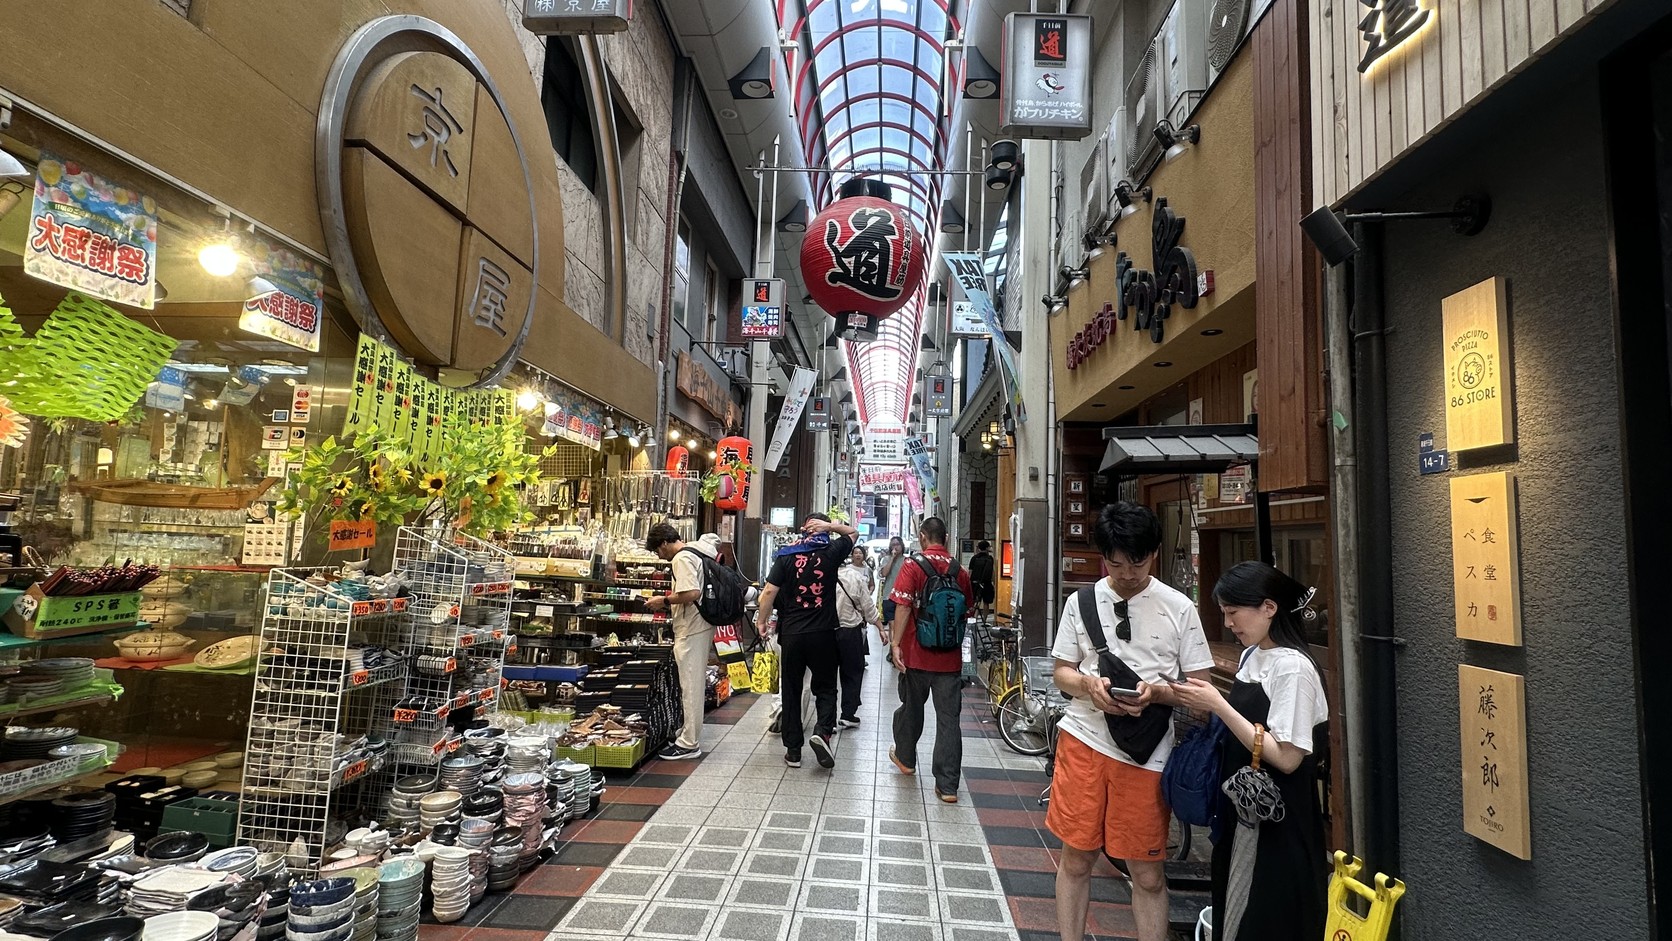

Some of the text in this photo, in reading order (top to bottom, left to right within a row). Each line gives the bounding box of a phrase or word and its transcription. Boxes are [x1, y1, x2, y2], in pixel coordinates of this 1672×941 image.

[1039, 31, 1065, 59] 道
[33, 213, 149, 284] 大感謝祭
[825, 208, 904, 301] 道
[1451, 330, 1489, 351] PROSCIUTTO
[1461, 341, 1478, 352] PIZZA
[349, 342, 371, 425] 大感謝セール
[391, 368, 406, 437] 大感謝セー
[1451, 386, 1496, 408] 86 STORE
[1463, 371, 1475, 385] 86
[421, 390, 435, 463] 大感謝セール
[1423, 454, 1445, 469] 14-7
[333, 530, 373, 541] 大感謝セール
[1481, 527, 1497, 581] 食堂
[1463, 528, 1478, 617] ペスカ
[944, 592, 957, 648] Superdry
[1477, 685, 1501, 794] 藤次郎
[1479, 814, 1505, 832] TOJIRO
